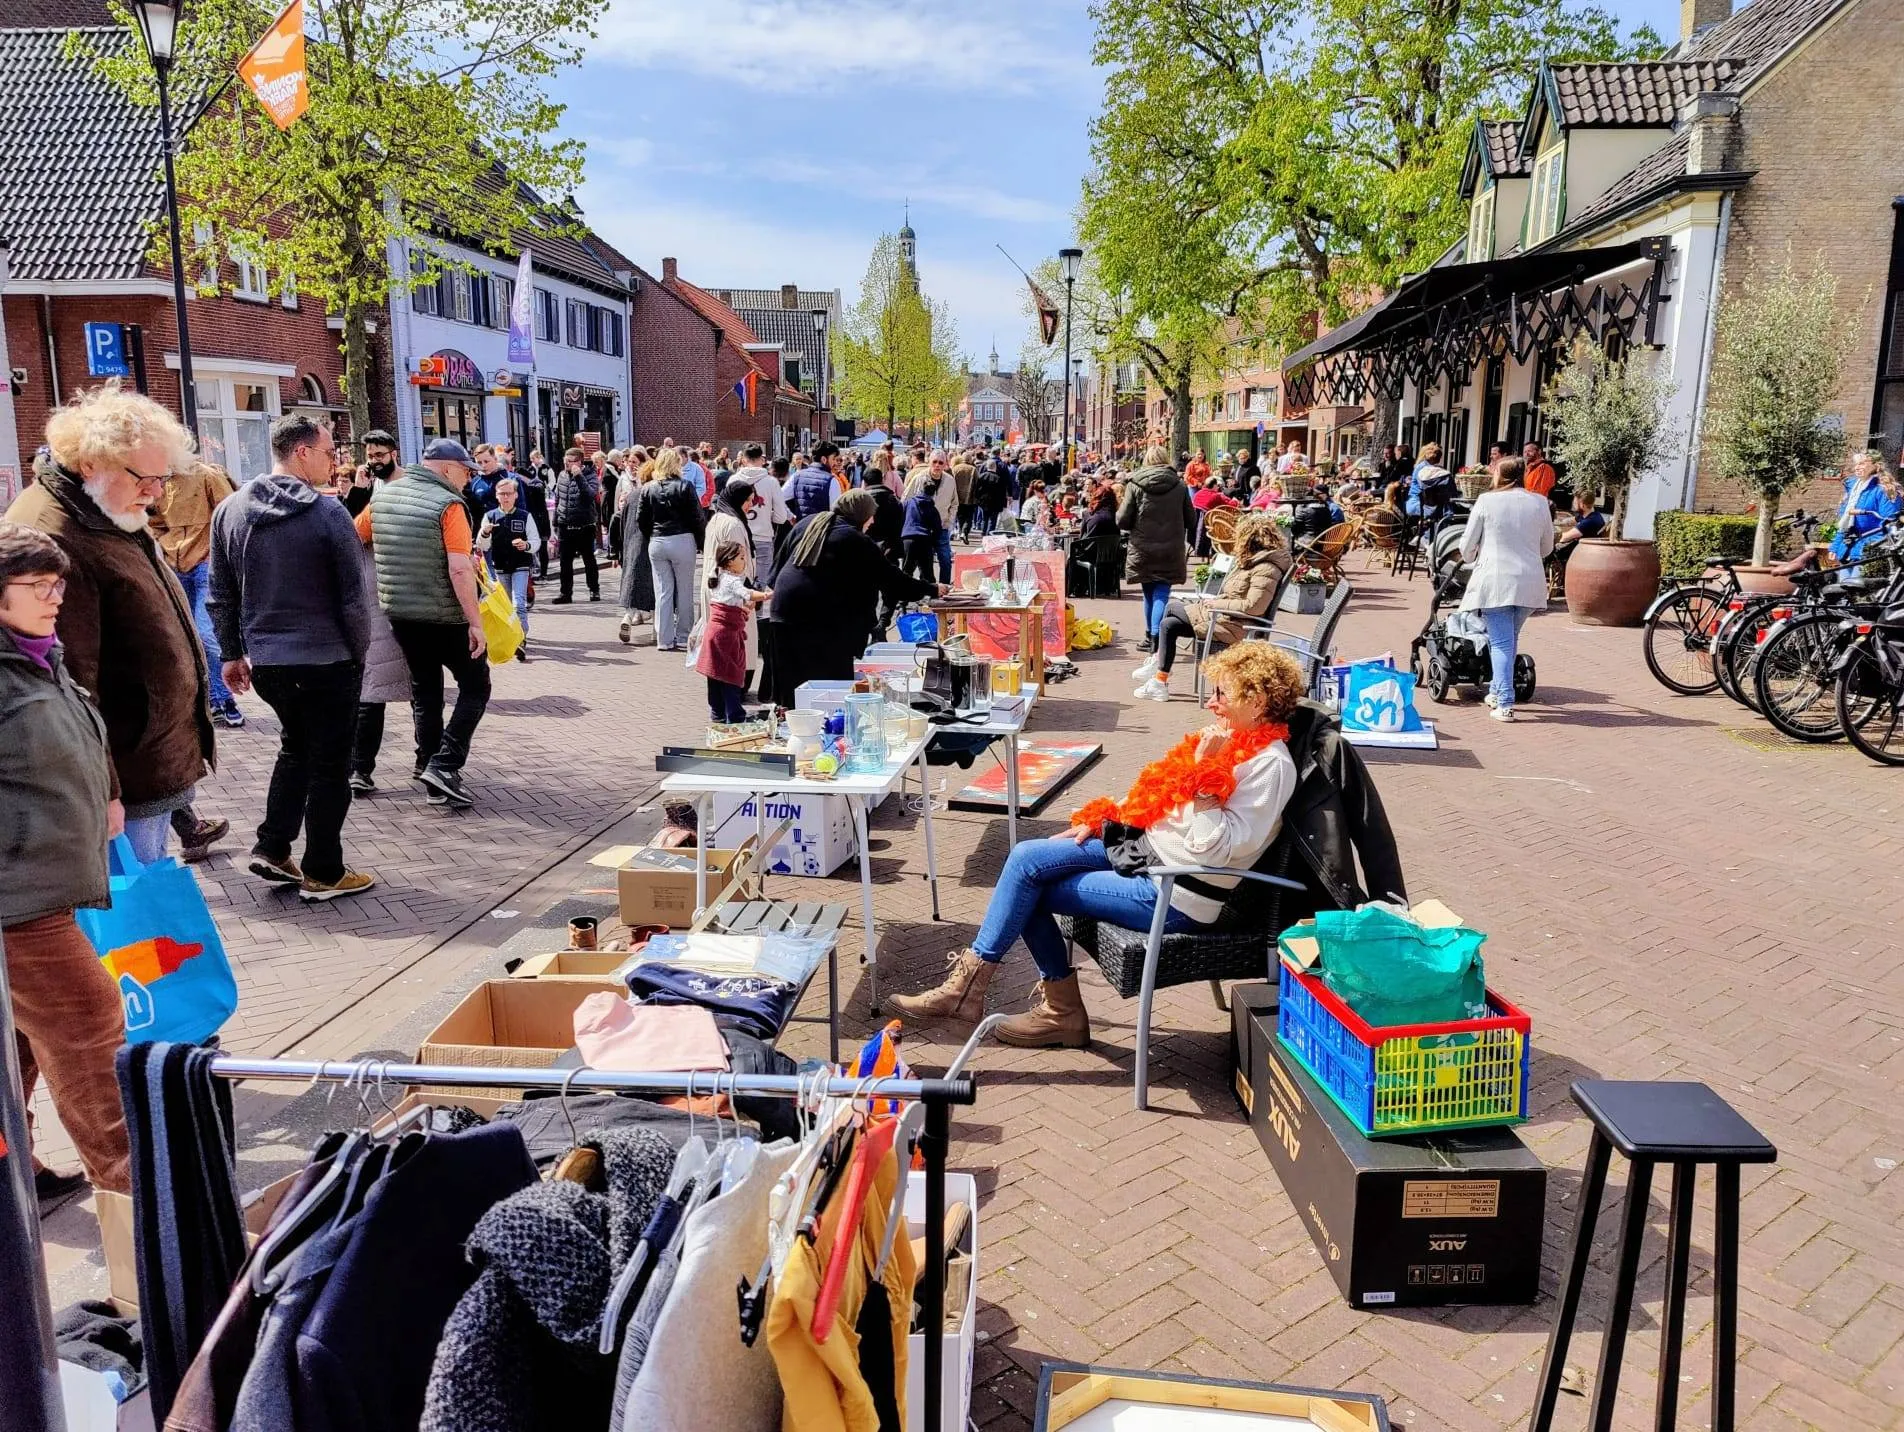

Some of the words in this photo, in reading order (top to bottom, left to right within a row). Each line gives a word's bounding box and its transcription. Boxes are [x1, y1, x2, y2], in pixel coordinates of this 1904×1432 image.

[95, 329, 113, 355] P
[1268, 1093, 1301, 1161] AUX
[1308, 1201, 1330, 1246] Inverter
[1429, 1240, 1468, 1250] AUX
